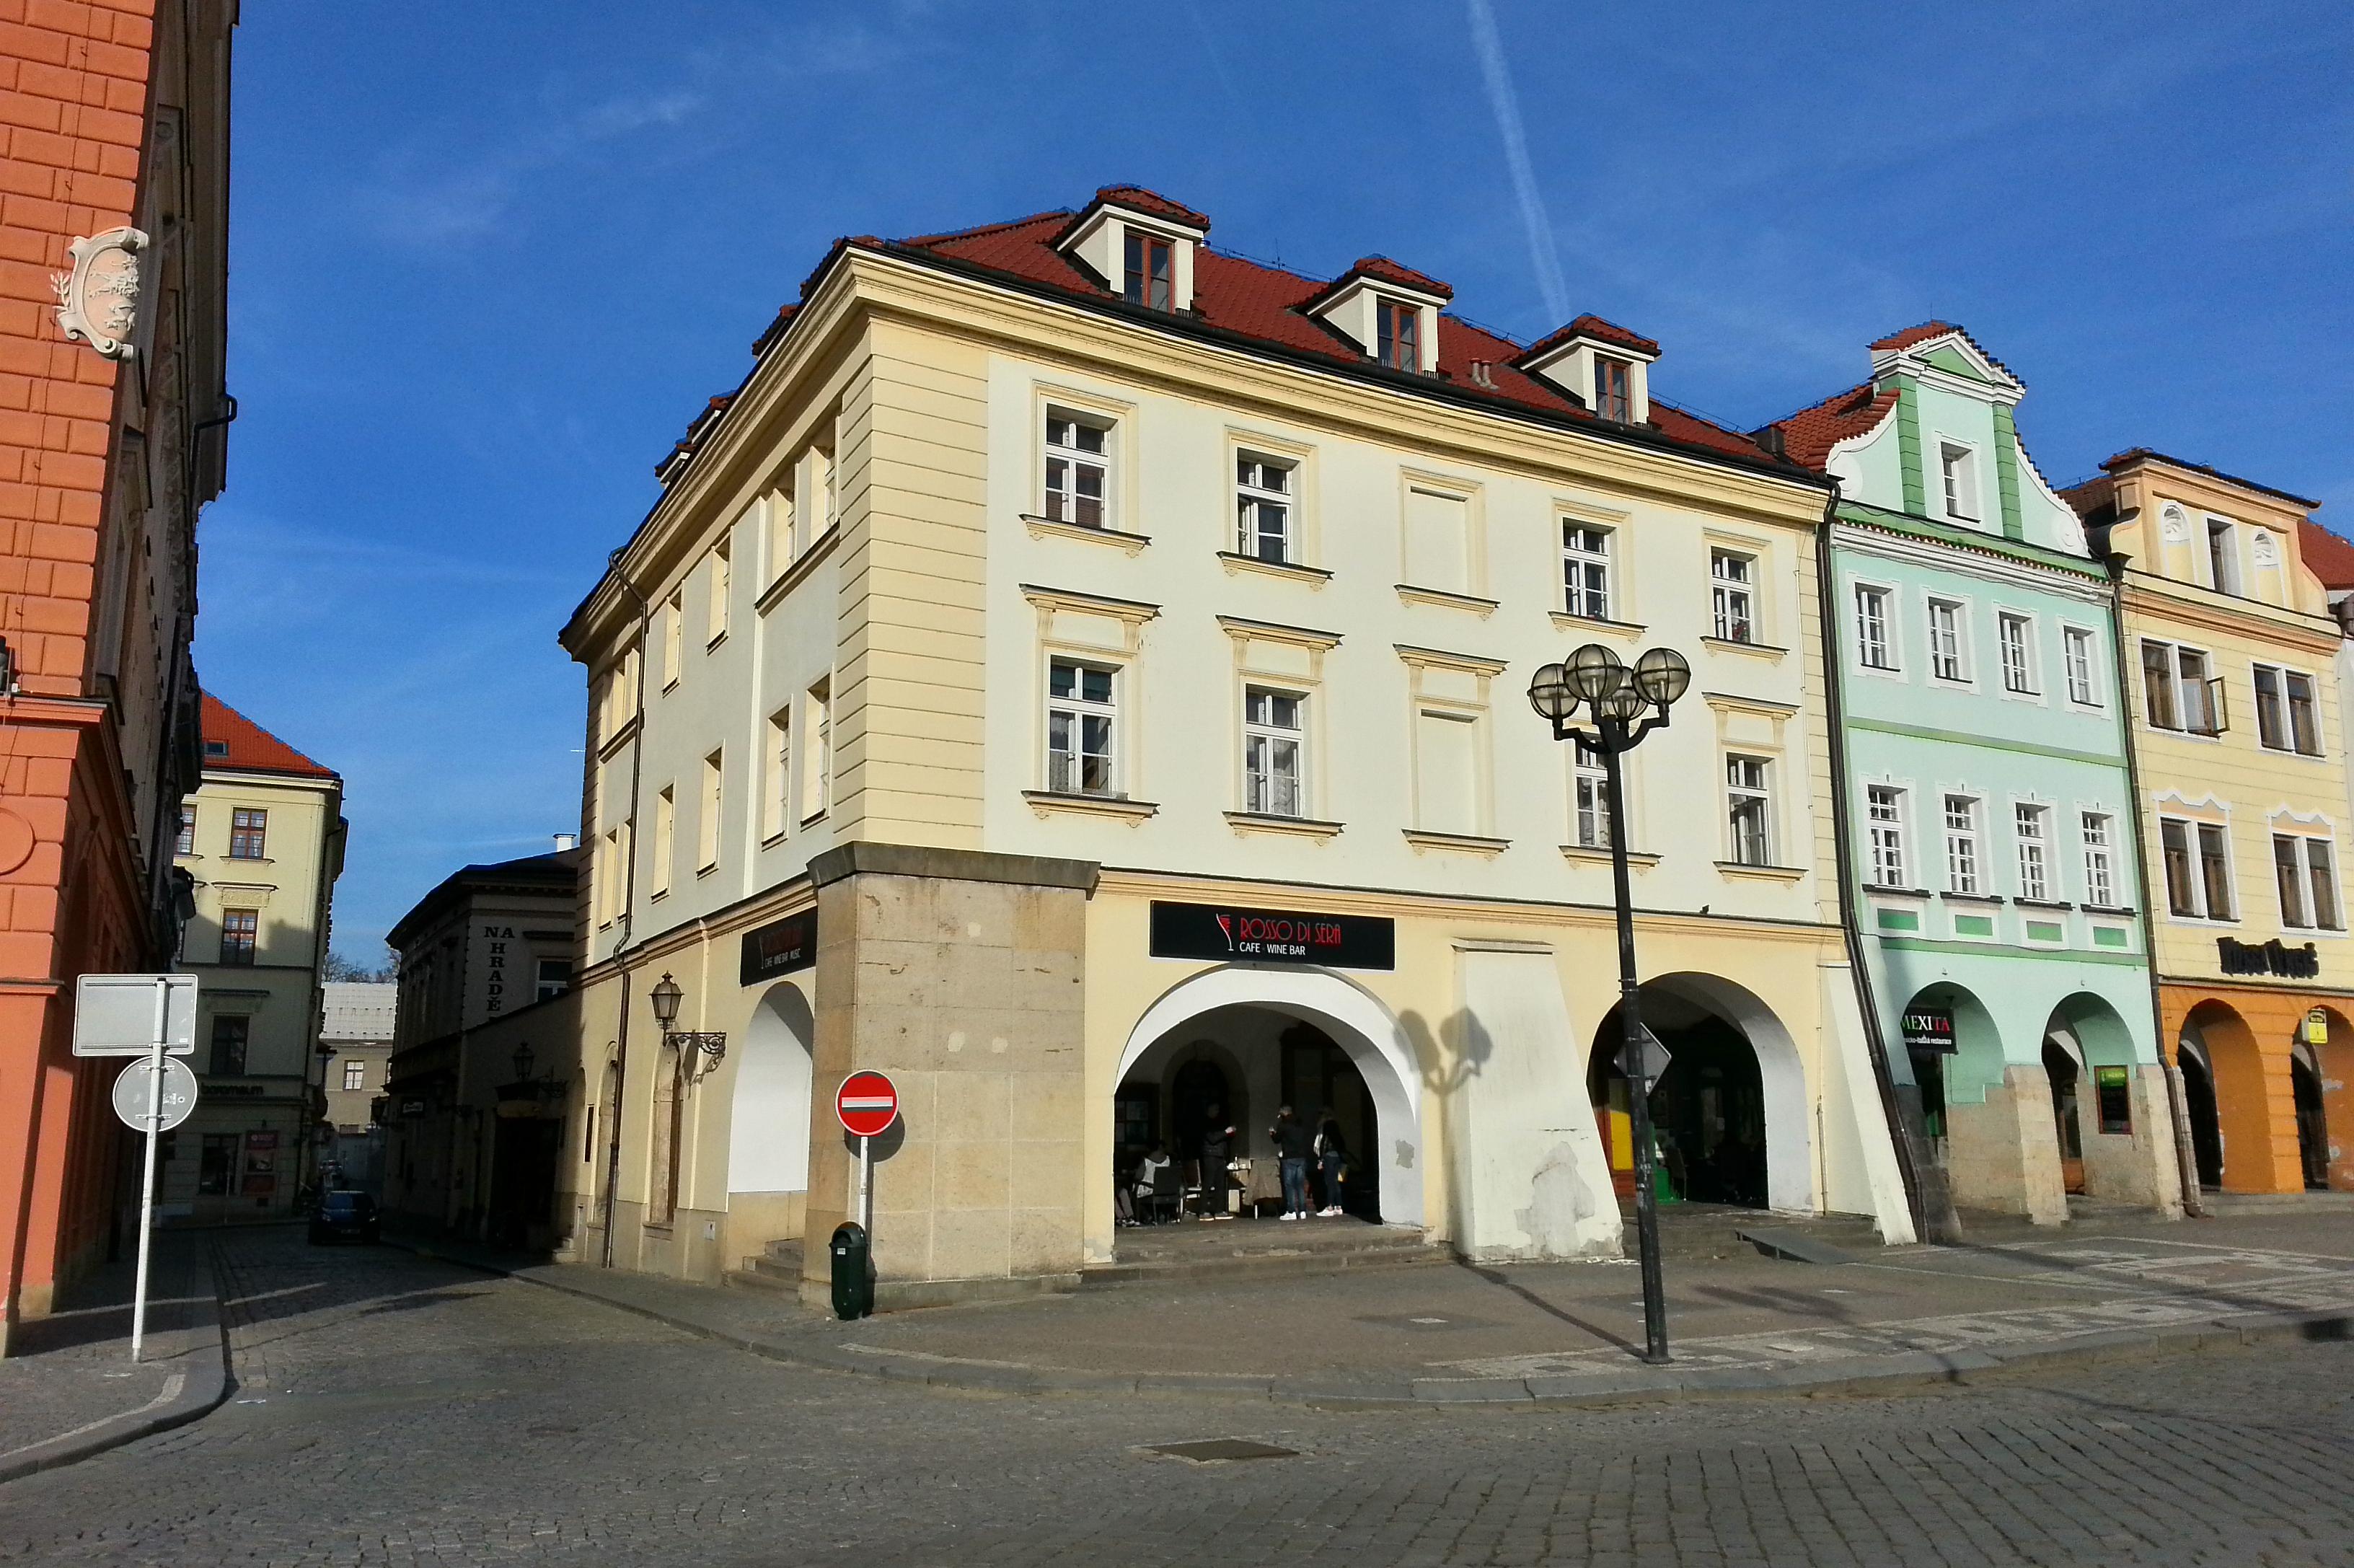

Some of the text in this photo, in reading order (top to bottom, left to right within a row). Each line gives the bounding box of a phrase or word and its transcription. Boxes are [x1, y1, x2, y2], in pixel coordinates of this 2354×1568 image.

[484, 926, 515, 938] NA
[1240, 917, 1341, 945] ROSSO DI SERA
[1239, 941, 1305, 956] CAFE WINE BAR
